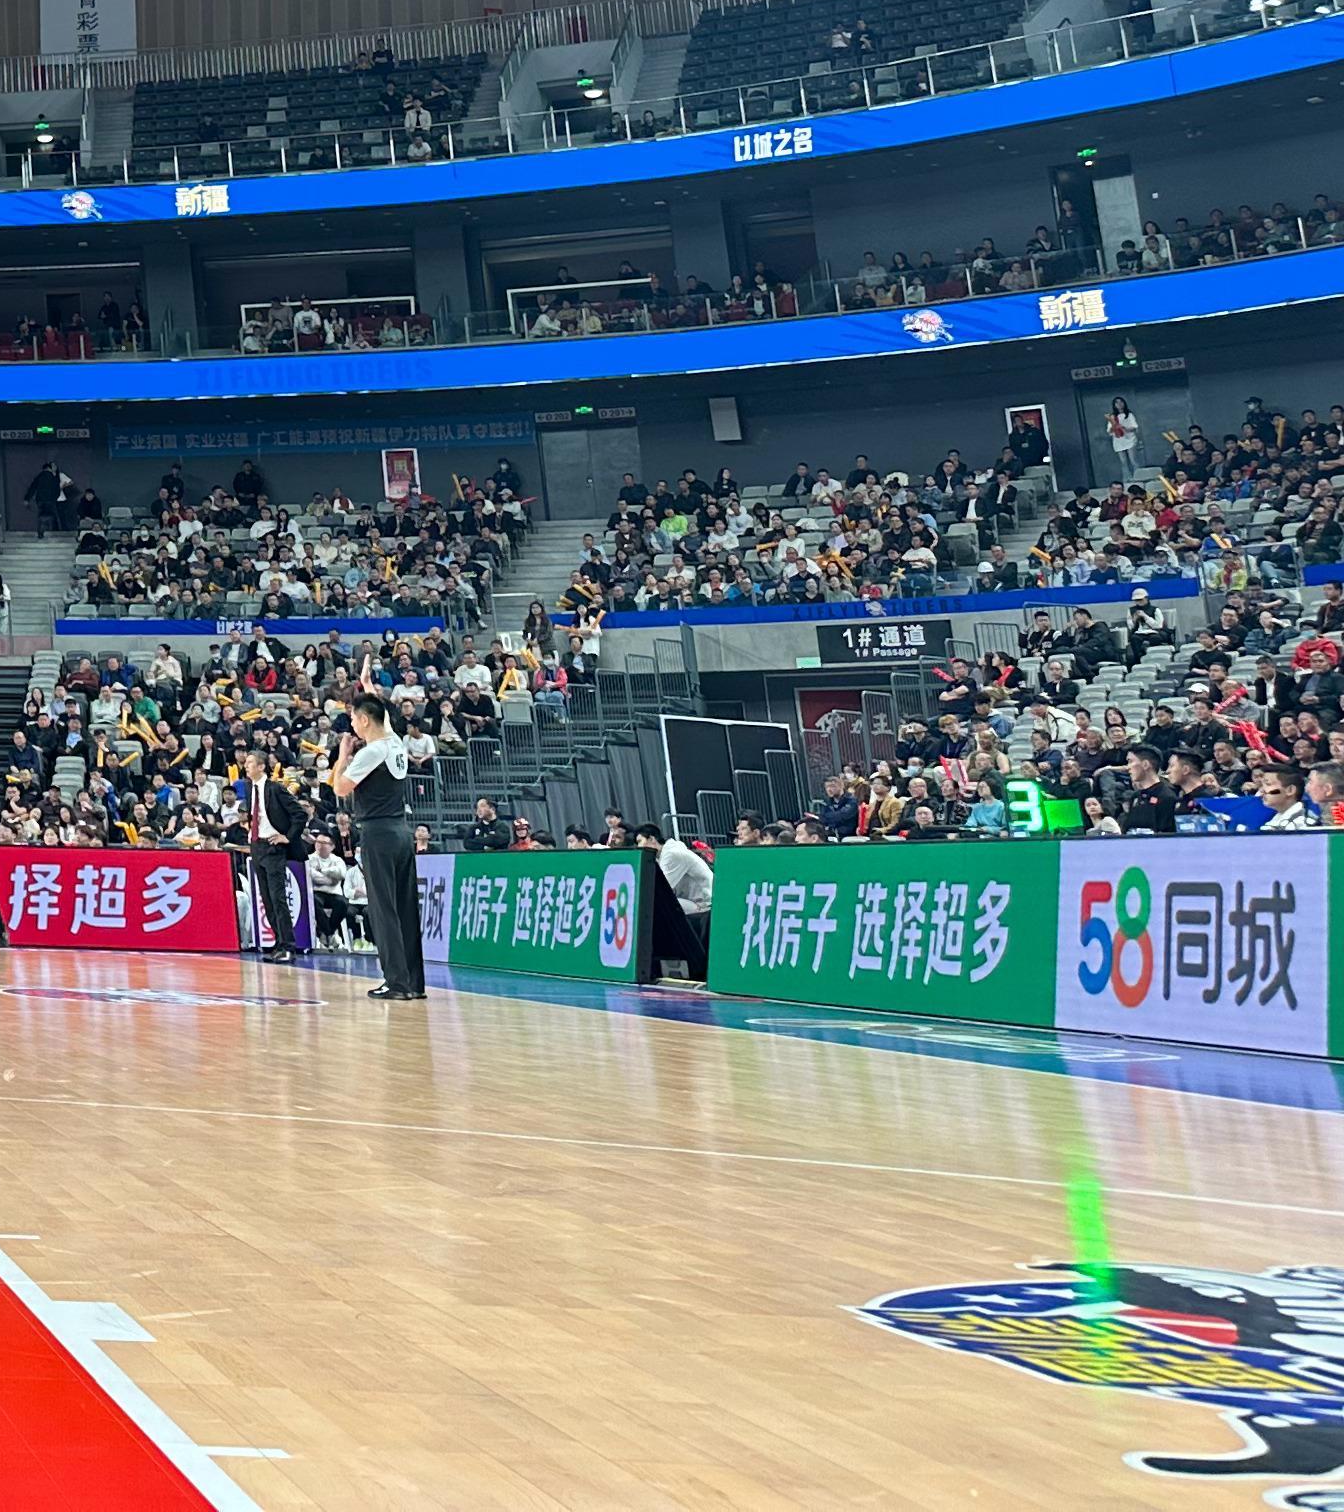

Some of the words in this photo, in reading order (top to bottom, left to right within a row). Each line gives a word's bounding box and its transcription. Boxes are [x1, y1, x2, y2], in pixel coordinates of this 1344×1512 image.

[733, 126, 812, 161] 以城之名
[175, 183, 230, 216] 新疆
[1039, 290, 1109, 330] 新疆
[878, 624, 926, 647] 通道
[455, 874, 508, 944] 找房子
[512, 872, 596, 951] 选择超多
[740, 879, 837, 973] 找房子
[848, 879, 1012, 985] 选择超多
